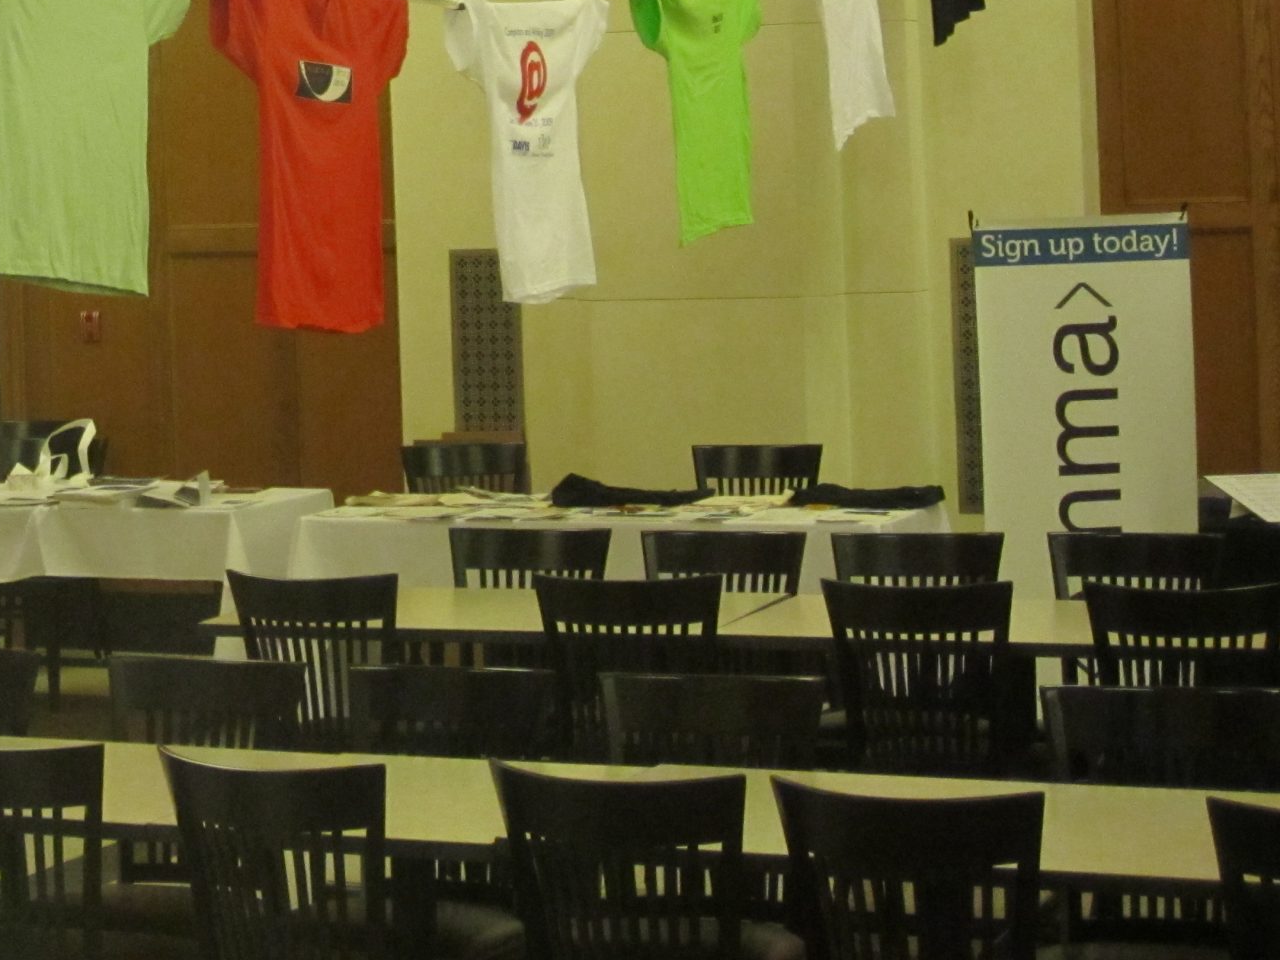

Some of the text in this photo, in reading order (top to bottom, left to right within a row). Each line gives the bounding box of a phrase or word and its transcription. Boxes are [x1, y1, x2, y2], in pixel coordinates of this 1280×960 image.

[981, 228, 1179, 263] Sign up today!
